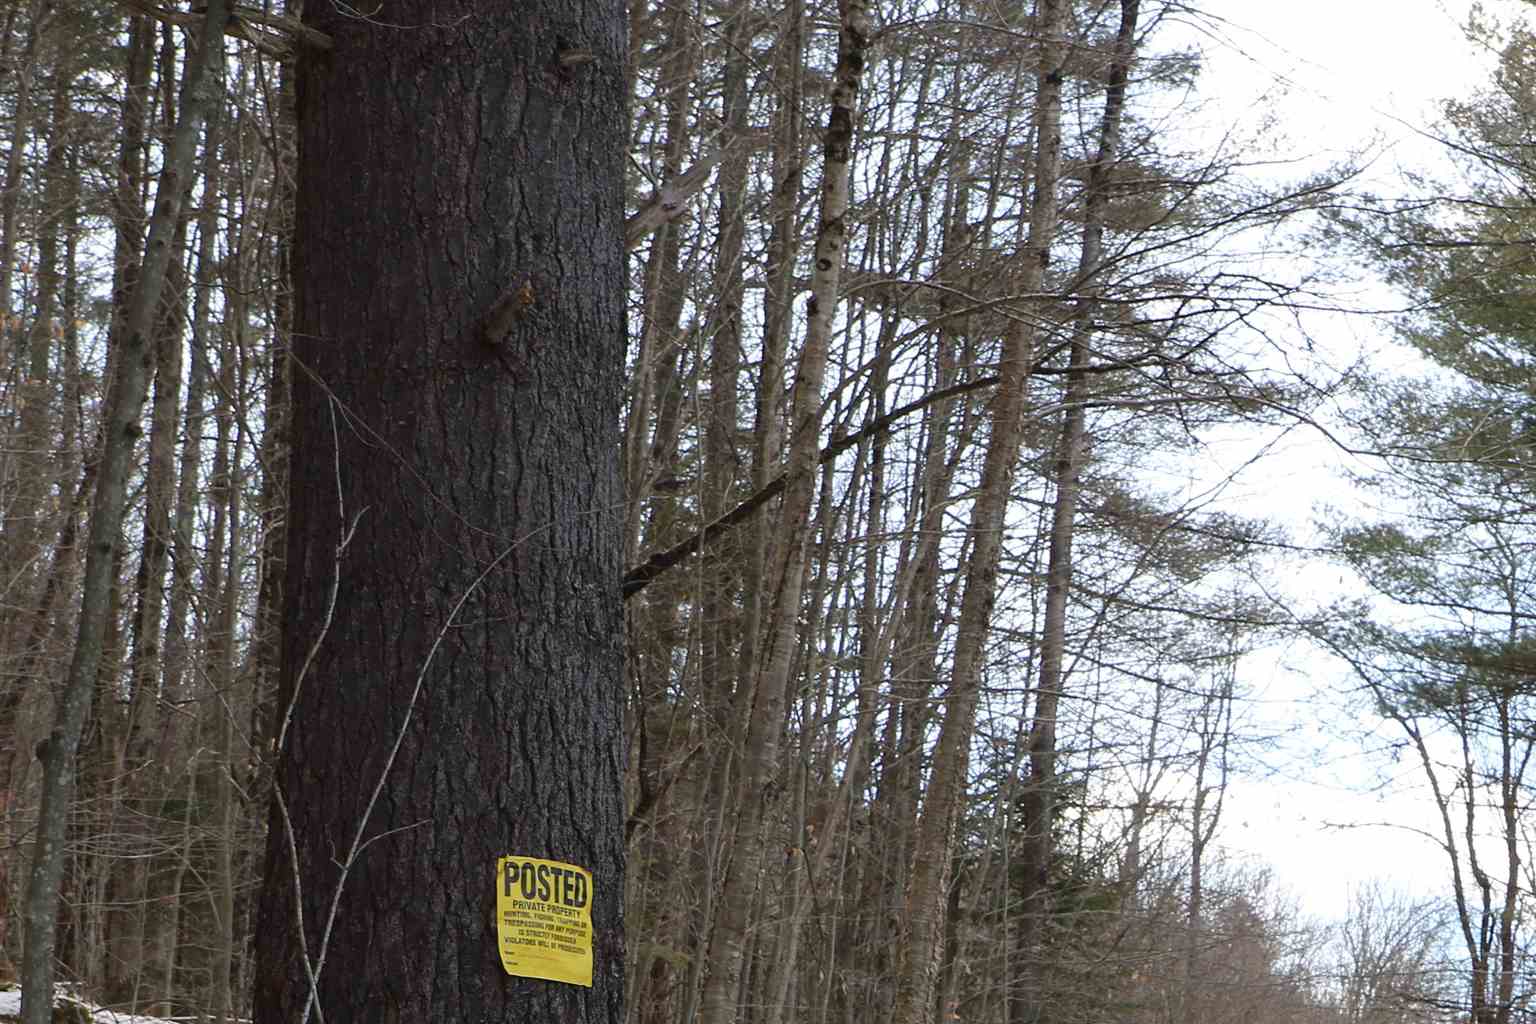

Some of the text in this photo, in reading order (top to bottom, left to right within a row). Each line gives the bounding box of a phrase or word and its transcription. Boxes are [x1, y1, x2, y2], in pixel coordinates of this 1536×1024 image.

[504, 861, 588, 908] POSTED
[512, 900, 546, 912] PRIVATE
[546, 904, 580, 918] PROPERTY
